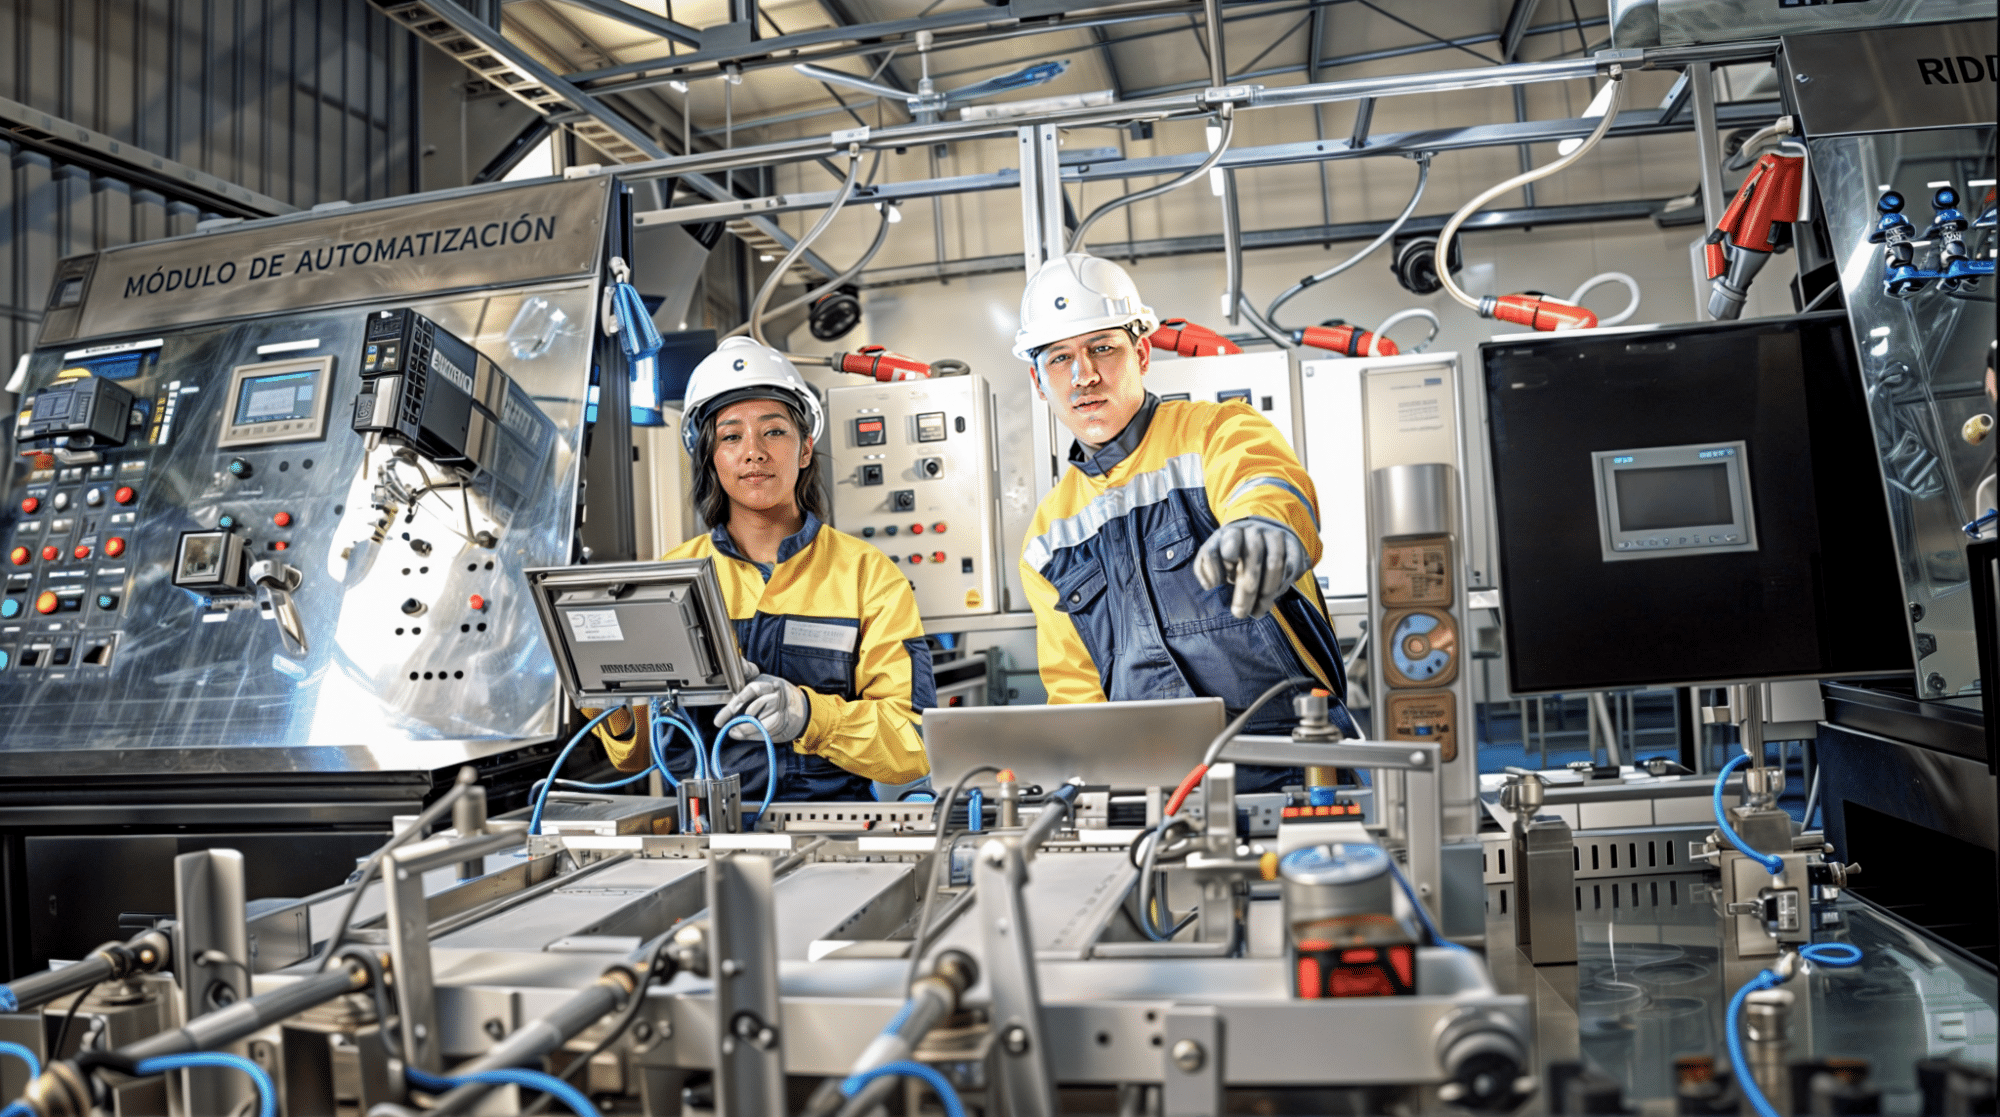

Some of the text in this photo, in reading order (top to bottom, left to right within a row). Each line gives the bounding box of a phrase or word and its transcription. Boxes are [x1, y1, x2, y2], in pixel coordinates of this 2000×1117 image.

[123, 213, 556, 299] MÓDULO DE AUTOMATIZACIÓN
